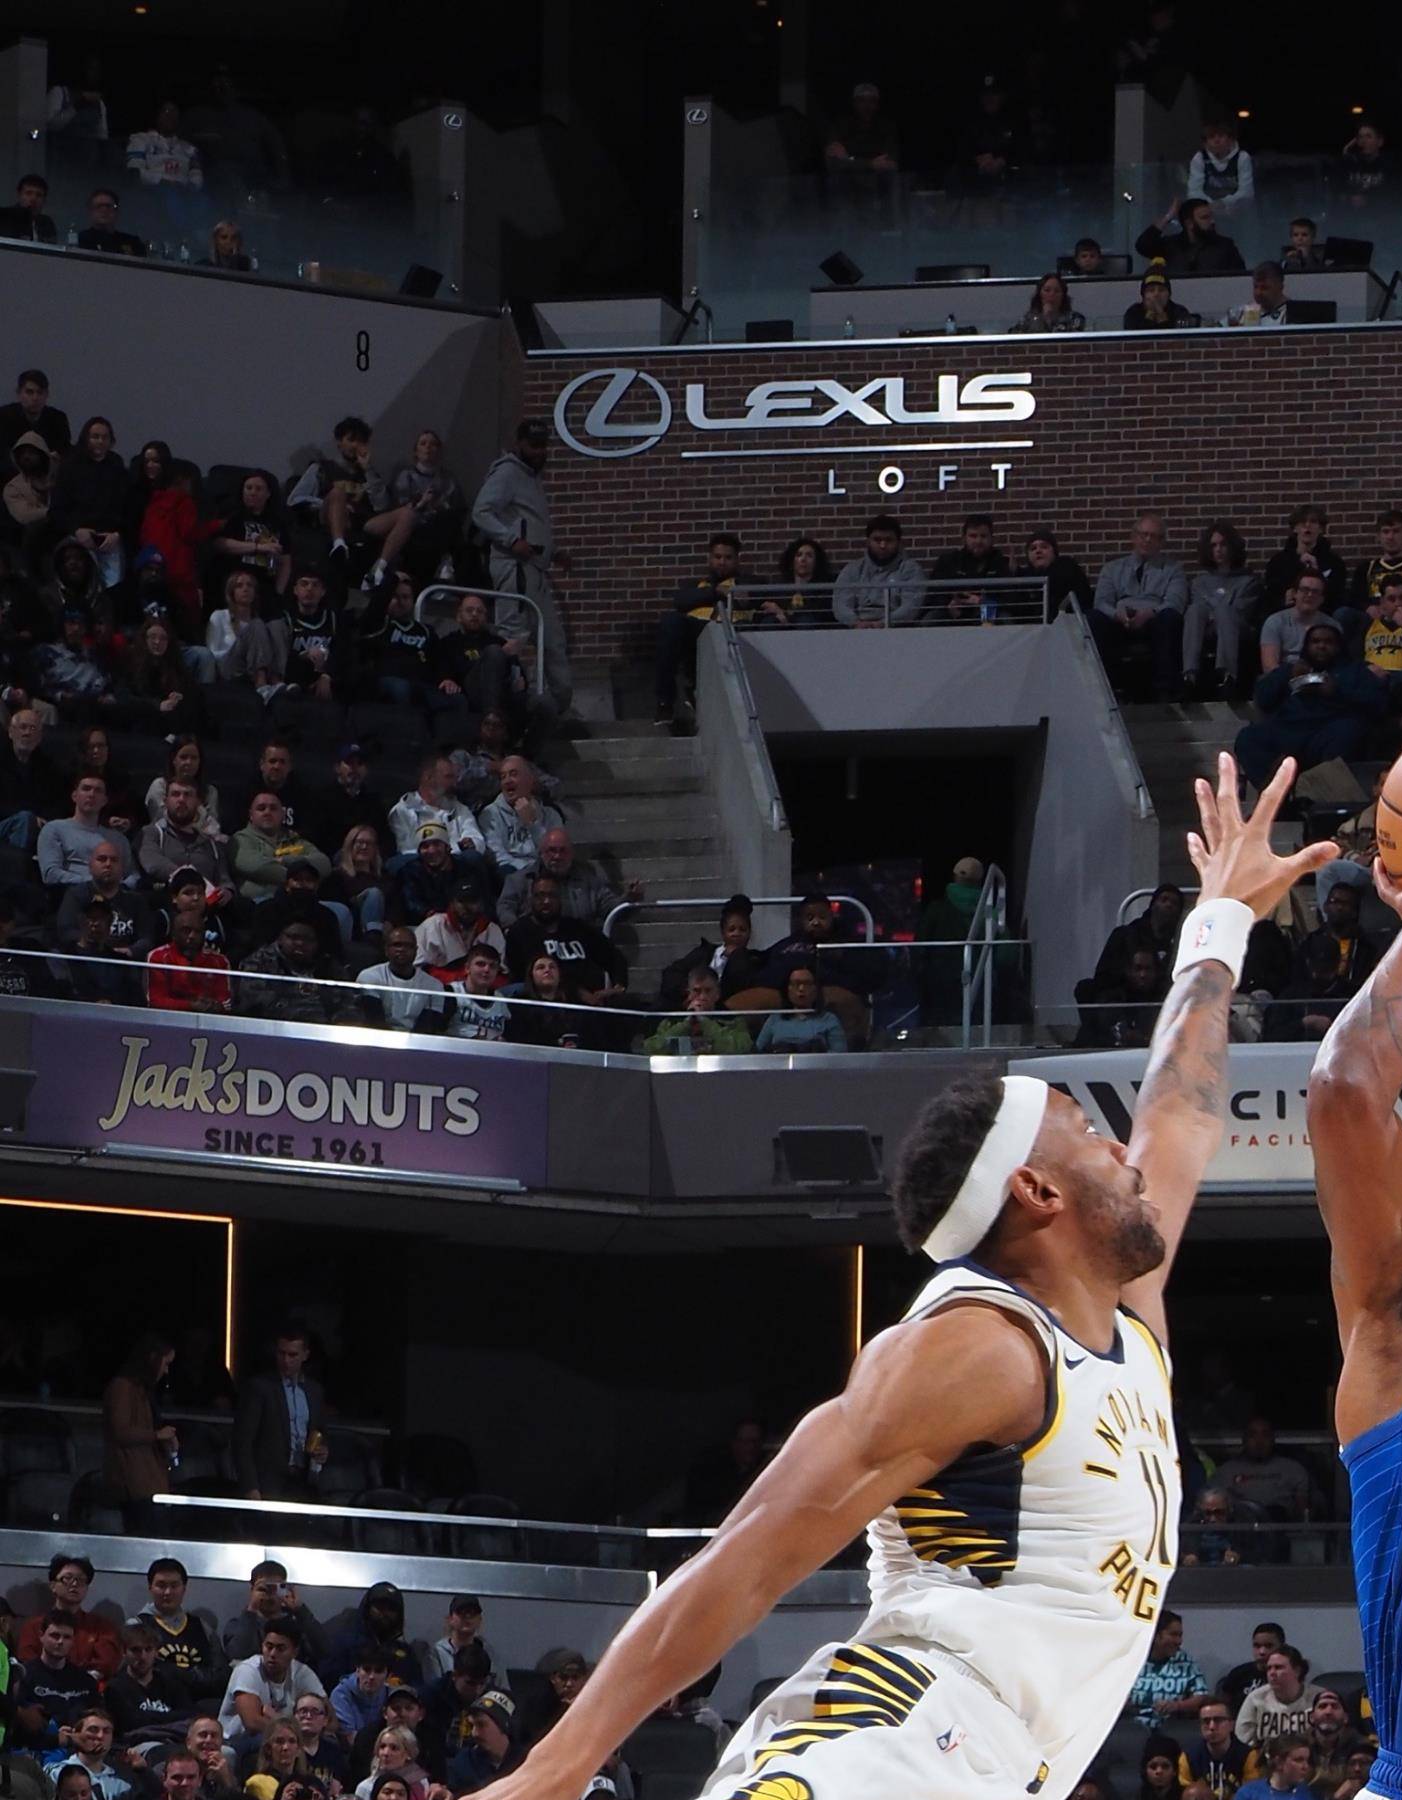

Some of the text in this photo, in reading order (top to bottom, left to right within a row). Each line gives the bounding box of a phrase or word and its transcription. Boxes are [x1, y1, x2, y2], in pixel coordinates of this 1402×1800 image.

[356, 331, 369, 371] 8
[686, 372, 1036, 430] LEXUS
[828, 463, 1012, 495] LOFT
[99, 1036, 480, 1137] Jack's DONUTS
[204, 1128, 385, 1166] SINCE 1961
[1231, 1132, 1313, 1147] FACIL
[1082, 1387, 1171, 1479] INDIAN
[1098, 1540, 1159, 1623] PAC
